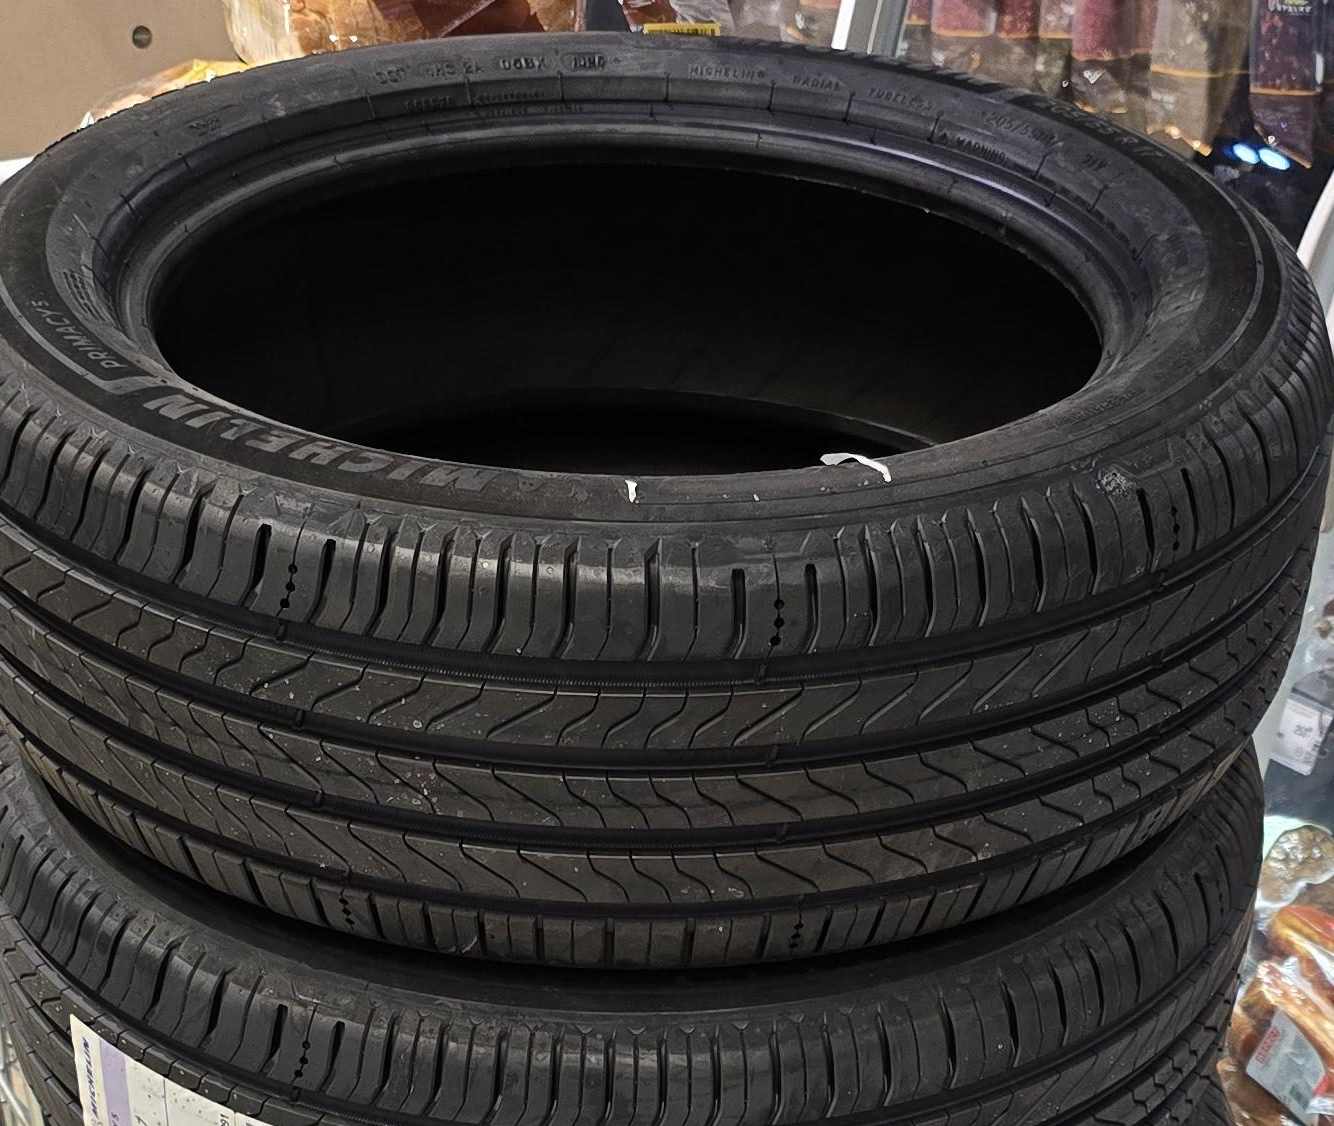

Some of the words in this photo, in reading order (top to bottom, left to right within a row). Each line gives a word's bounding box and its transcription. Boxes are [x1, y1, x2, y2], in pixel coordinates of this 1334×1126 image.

[36, 307, 128, 369] PRIMACY
[143, 395, 495, 492] MICHELIN
[83, 1037, 99, 1119] MICHELIN
